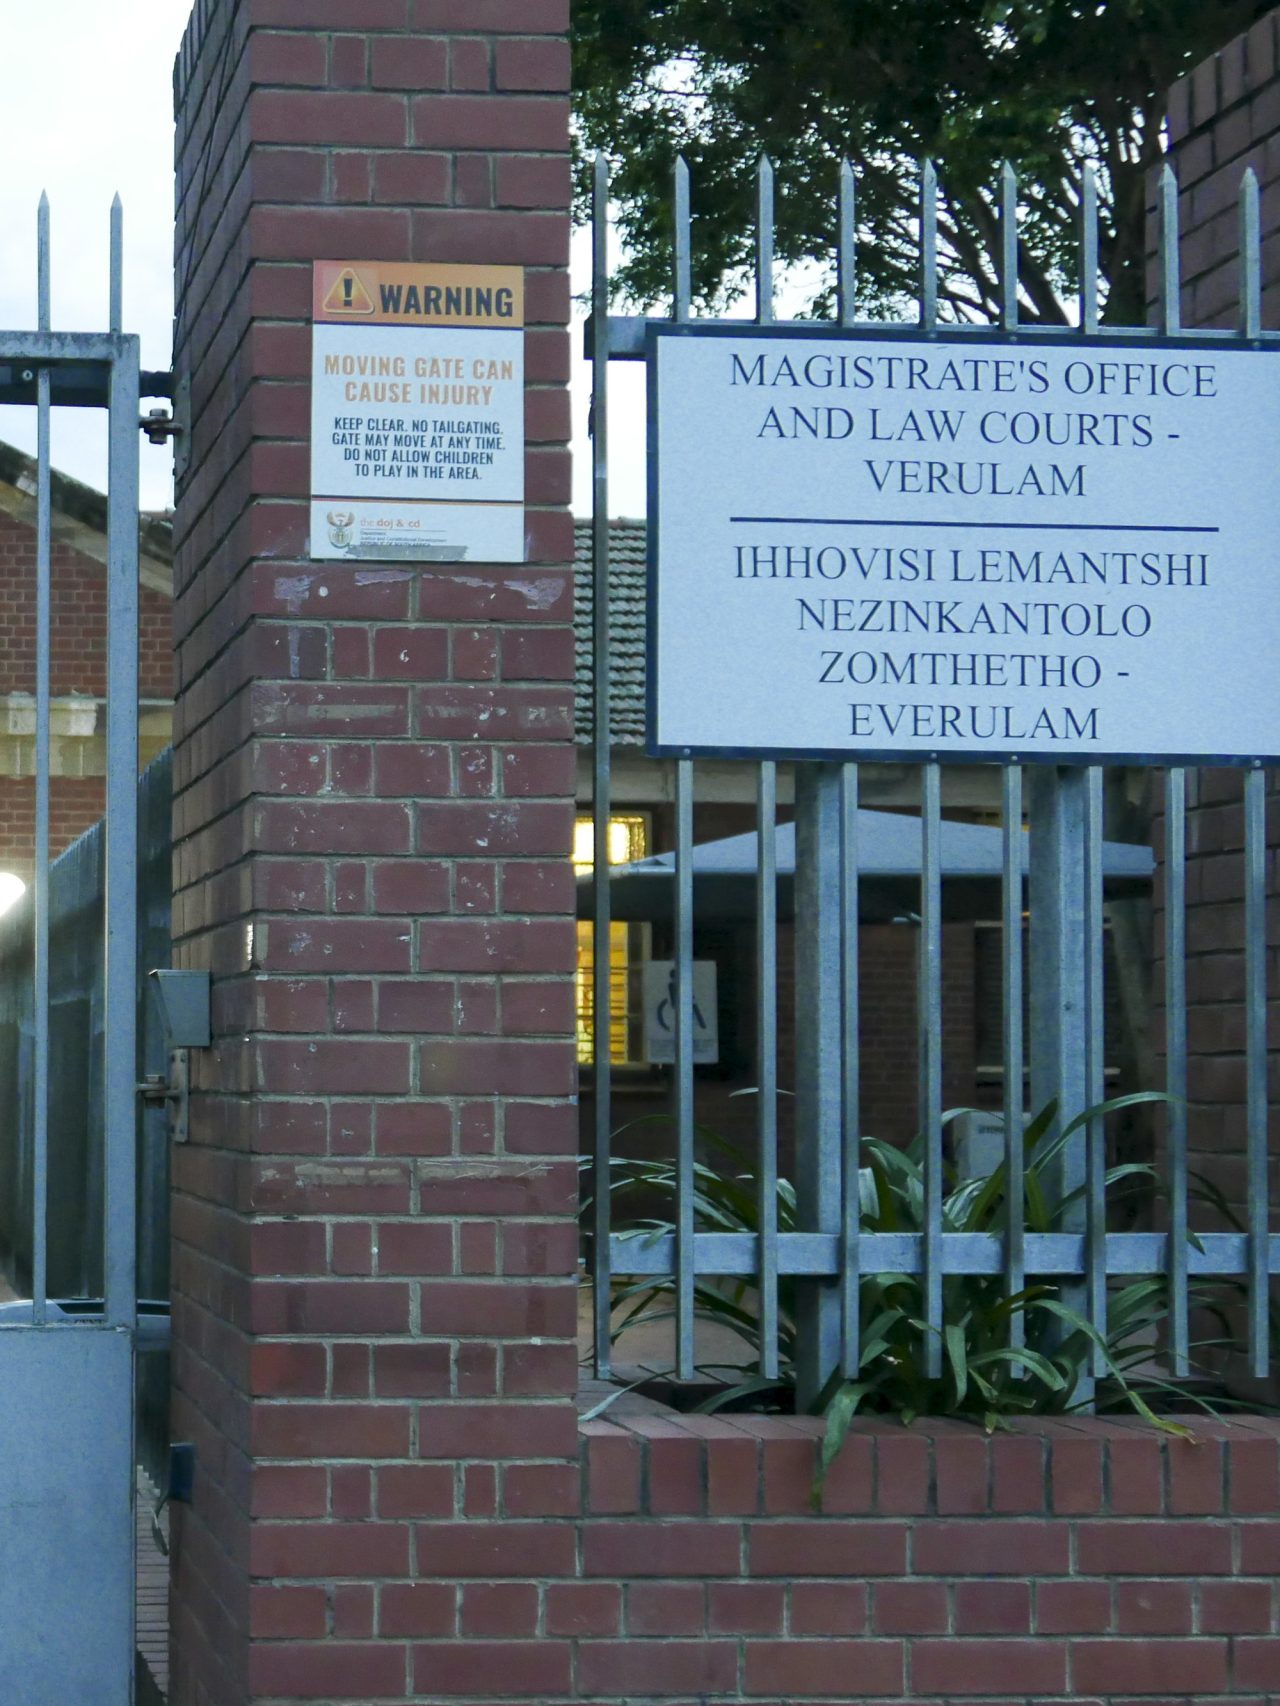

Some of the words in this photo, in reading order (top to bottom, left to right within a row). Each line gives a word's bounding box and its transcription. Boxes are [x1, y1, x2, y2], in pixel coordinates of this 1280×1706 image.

[379, 284, 513, 317] WARNING
[324, 355, 405, 377] MOVING
[414, 358, 464, 379] GATE
[472, 360, 513, 380] CAN
[731, 354, 1050, 393] MAGISTRATE'S
[1065, 362, 1218, 397] OFFICE
[345, 382, 412, 403] CAUSE
[420, 383, 493, 406] INJURY
[332, 433, 360, 446] GATE
[365, 434, 390, 447] MAY
[394, 435, 426, 448] MOVE
[430, 436, 446, 448] AT
[448, 436, 471, 449] ANY
[475, 437, 506, 450] TIME.
[334, 417, 363, 431] KEEP
[367, 418, 408, 432] CLEAR.
[412, 420, 428, 433] NO
[432, 420, 503, 435] TAILGATING.
[757, 406, 854, 439] AND
[869, 409, 966, 442] LAW
[980, 411, 1153, 447] COURTS
[344, 448, 360, 461] DO
[364, 449, 386, 462] NOT
[391, 449, 431, 463] ALLOW
[434, 451, 494, 465] CHILDREN
[355, 463, 369, 477] TO
[374, 464, 403, 478] PLAY
[406, 465, 419, 478] IN
[423, 466, 444, 479] THE
[448, 466, 483, 480] AREA.
[864, 460, 1087, 496] VERULAM
[376, 518, 393, 529] doj
[408, 519, 420, 528] cd
[734, 546, 935, 581] IHHOVISI
[951, 550, 1209, 586] LEMANTSHI
[796, 599, 1152, 637] NEZINKANTOLO
[819, 651, 1102, 688] ZOMTHETHO
[849, 704, 1099, 740] EVERULAM
